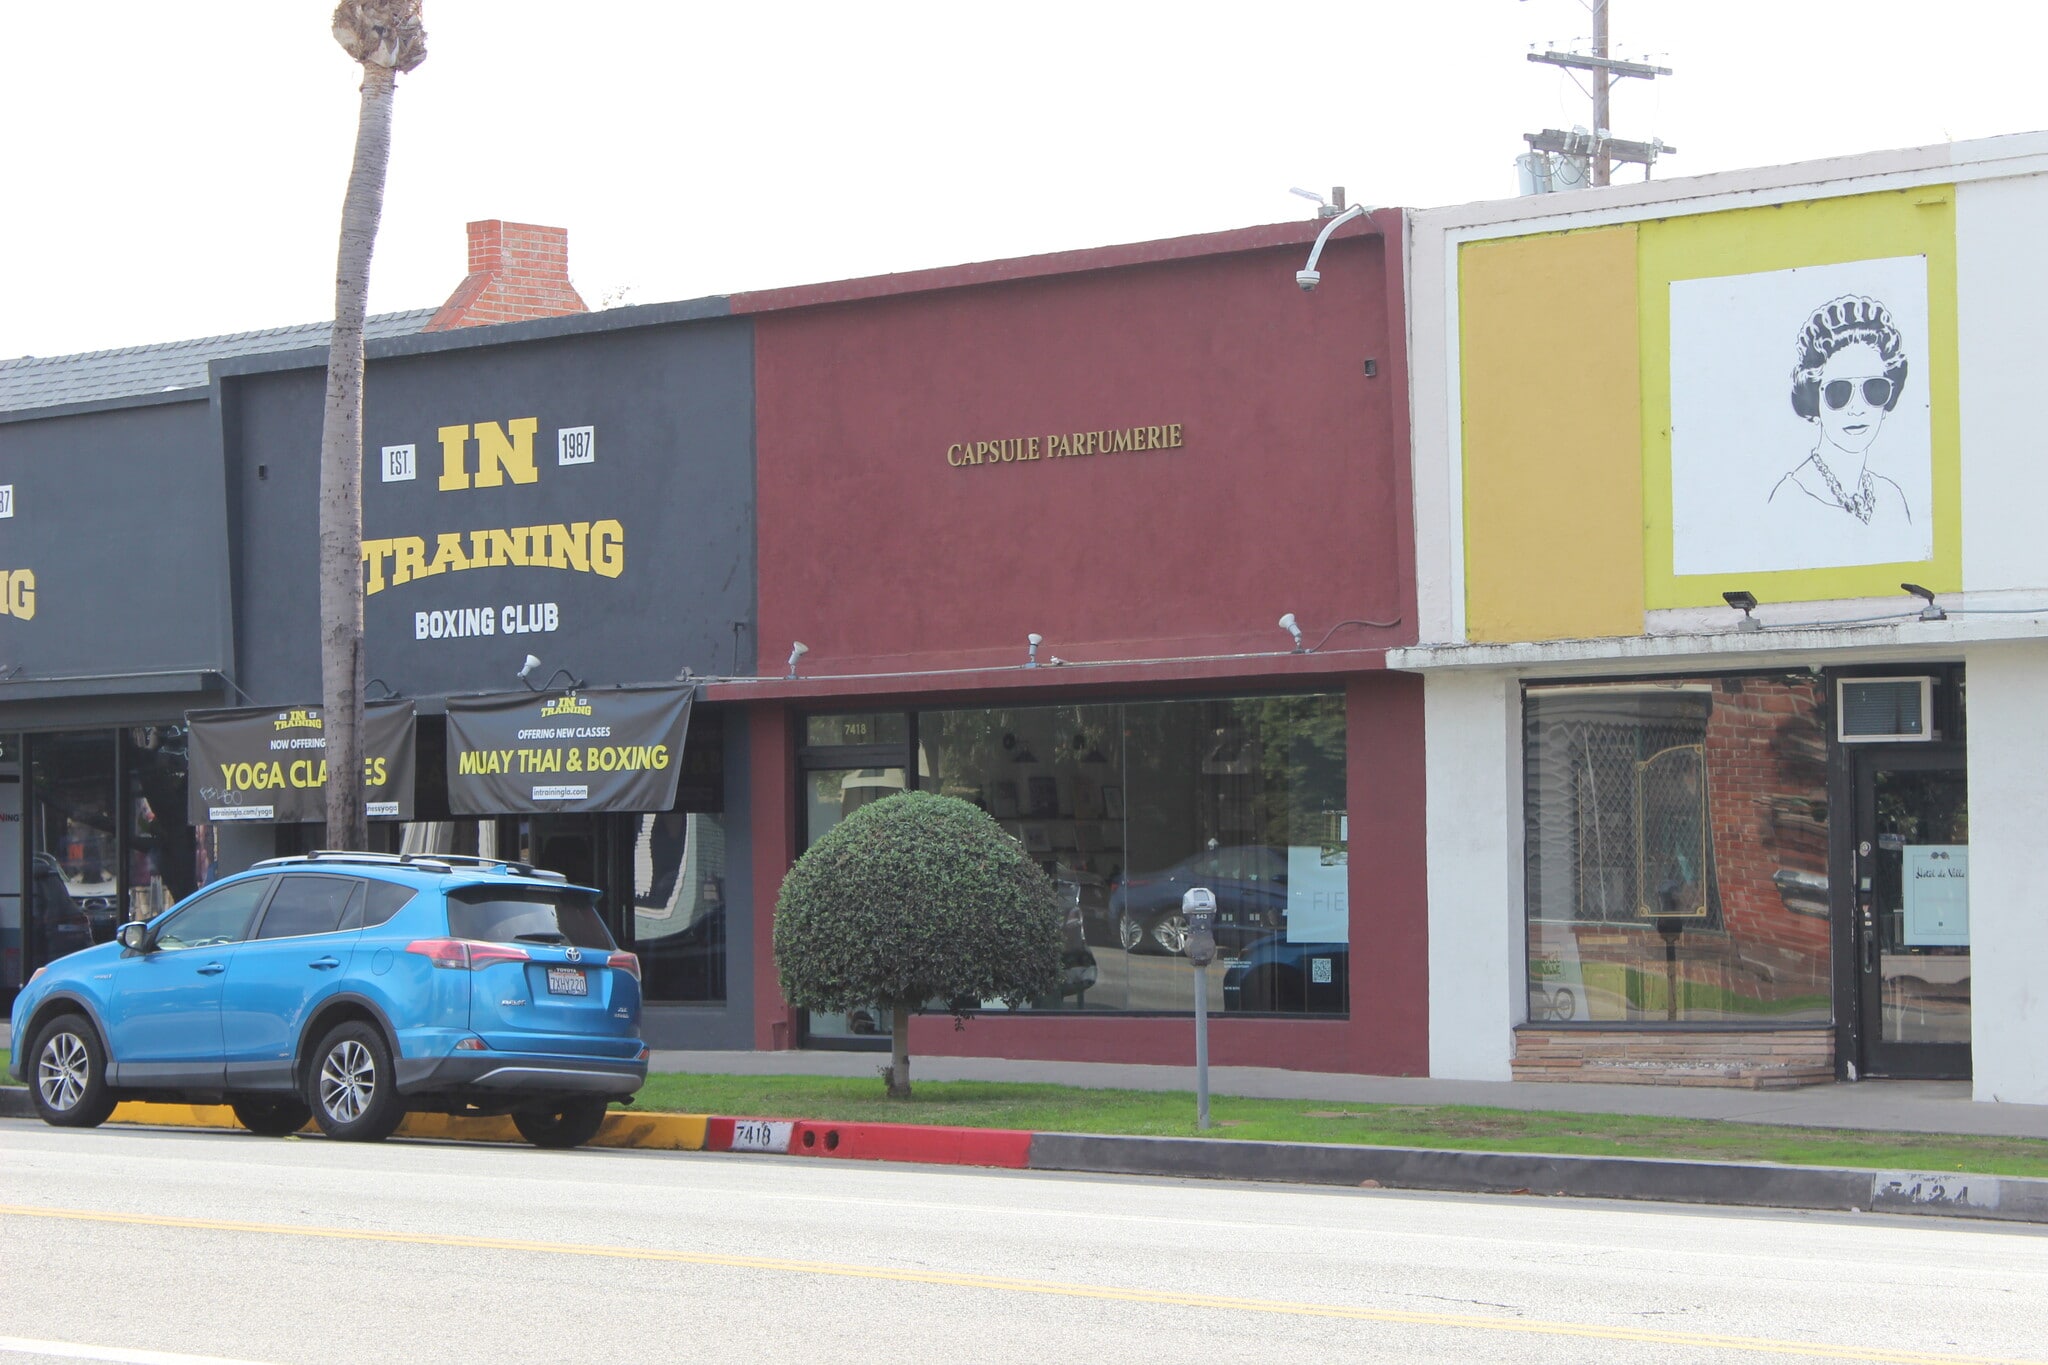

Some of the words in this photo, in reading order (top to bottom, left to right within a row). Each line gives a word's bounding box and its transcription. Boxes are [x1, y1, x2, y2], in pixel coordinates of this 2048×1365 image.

[438, 417, 538, 492] IN
[562, 432, 591, 459] 1987
[947, 437, 1040, 467] CAPSULE
[1047, 424, 1183, 458] PARFUMERIE
[390, 450, 411, 476] EST.
[361, 519, 624, 596] TRAINING
[415, 607, 495, 640] BOXING
[501, 603, 559, 635] CLUB
[273, 718, 322, 731] TRAINING
[541, 705, 592, 718] TRAINING
[518, 728, 556, 740] OFFERING
[556, 728, 576, 738] NEW
[576, 726, 611, 737] CLASSES
[844, 723, 867, 735] 7418
[270, 739, 289, 750] NOW
[290, 738, 326, 749] OFFERING
[459, 749, 514, 775] MUAY
[518, 747, 561, 773] THAI
[566, 748, 582, 772] &
[587, 744, 670, 772] BOXING
[220, 761, 286, 791] YOGA
[736, 1124, 771, 1147] 7418
